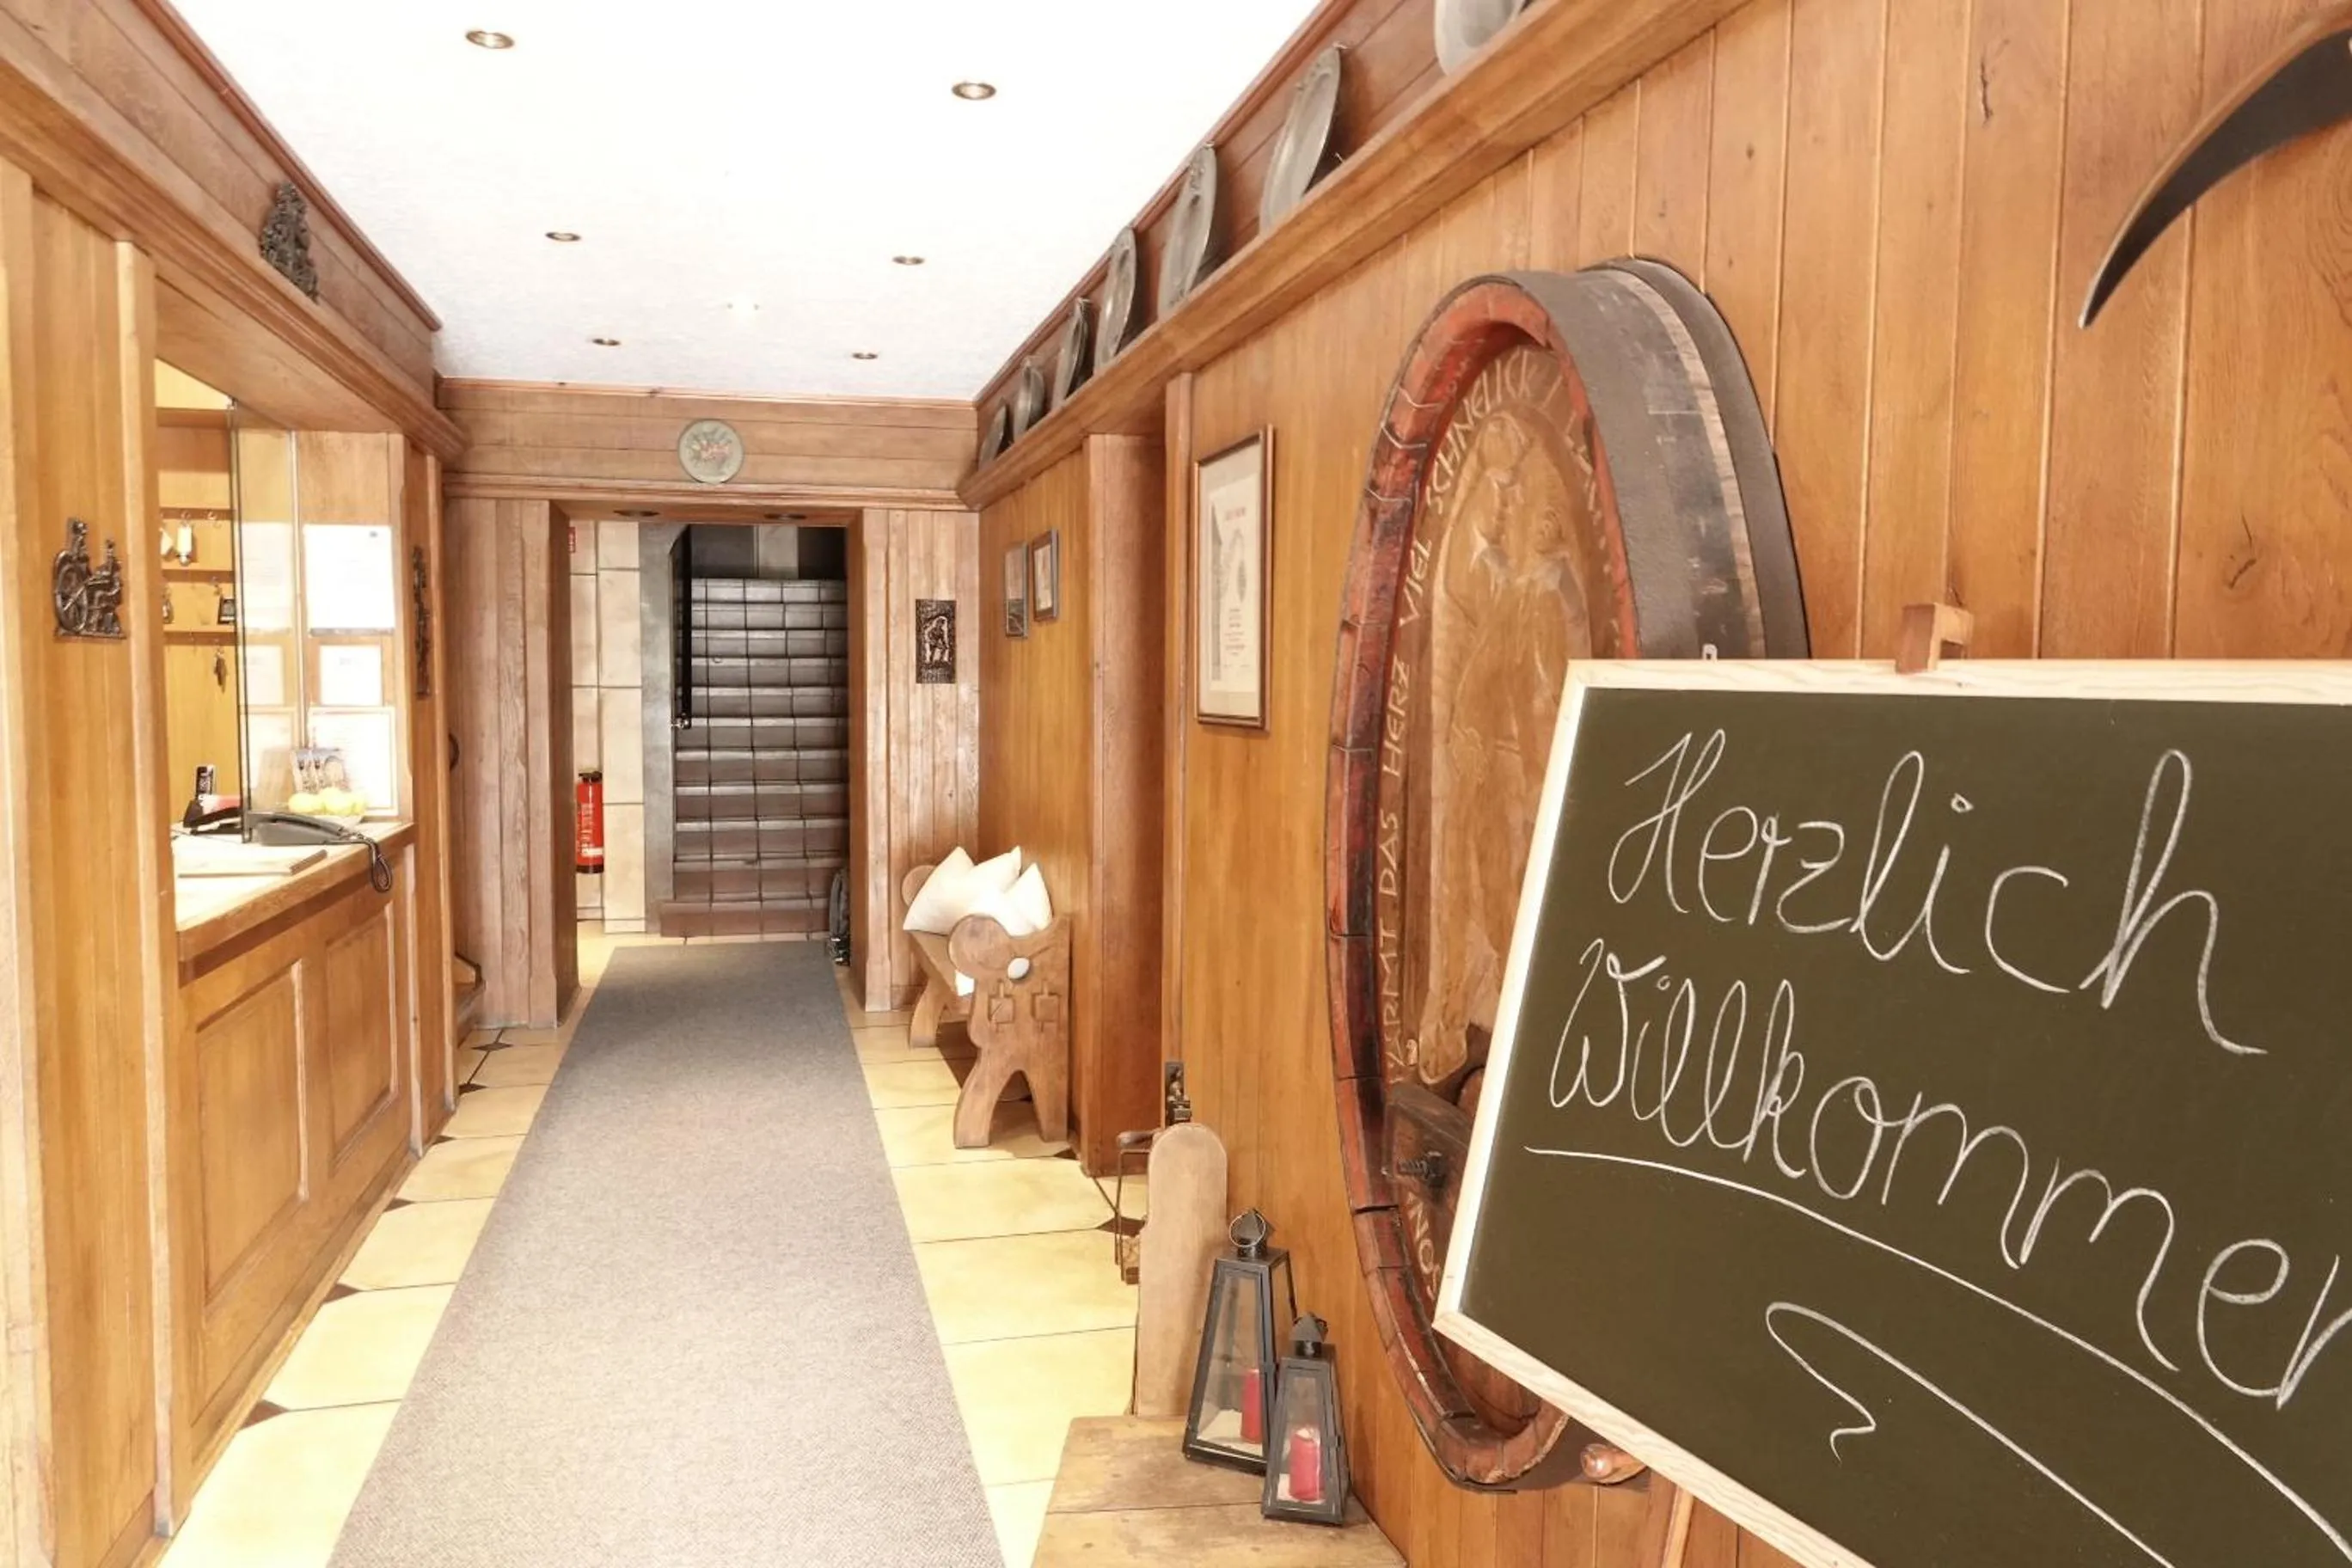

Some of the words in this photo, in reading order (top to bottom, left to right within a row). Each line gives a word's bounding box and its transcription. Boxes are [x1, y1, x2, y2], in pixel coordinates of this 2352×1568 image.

[1398, 536, 1433, 628] VIEL
[1381, 653, 1411, 778] HERZ
[1378, 808, 1400, 897] DAS
[1608, 727, 2268, 1054] Herzlich
